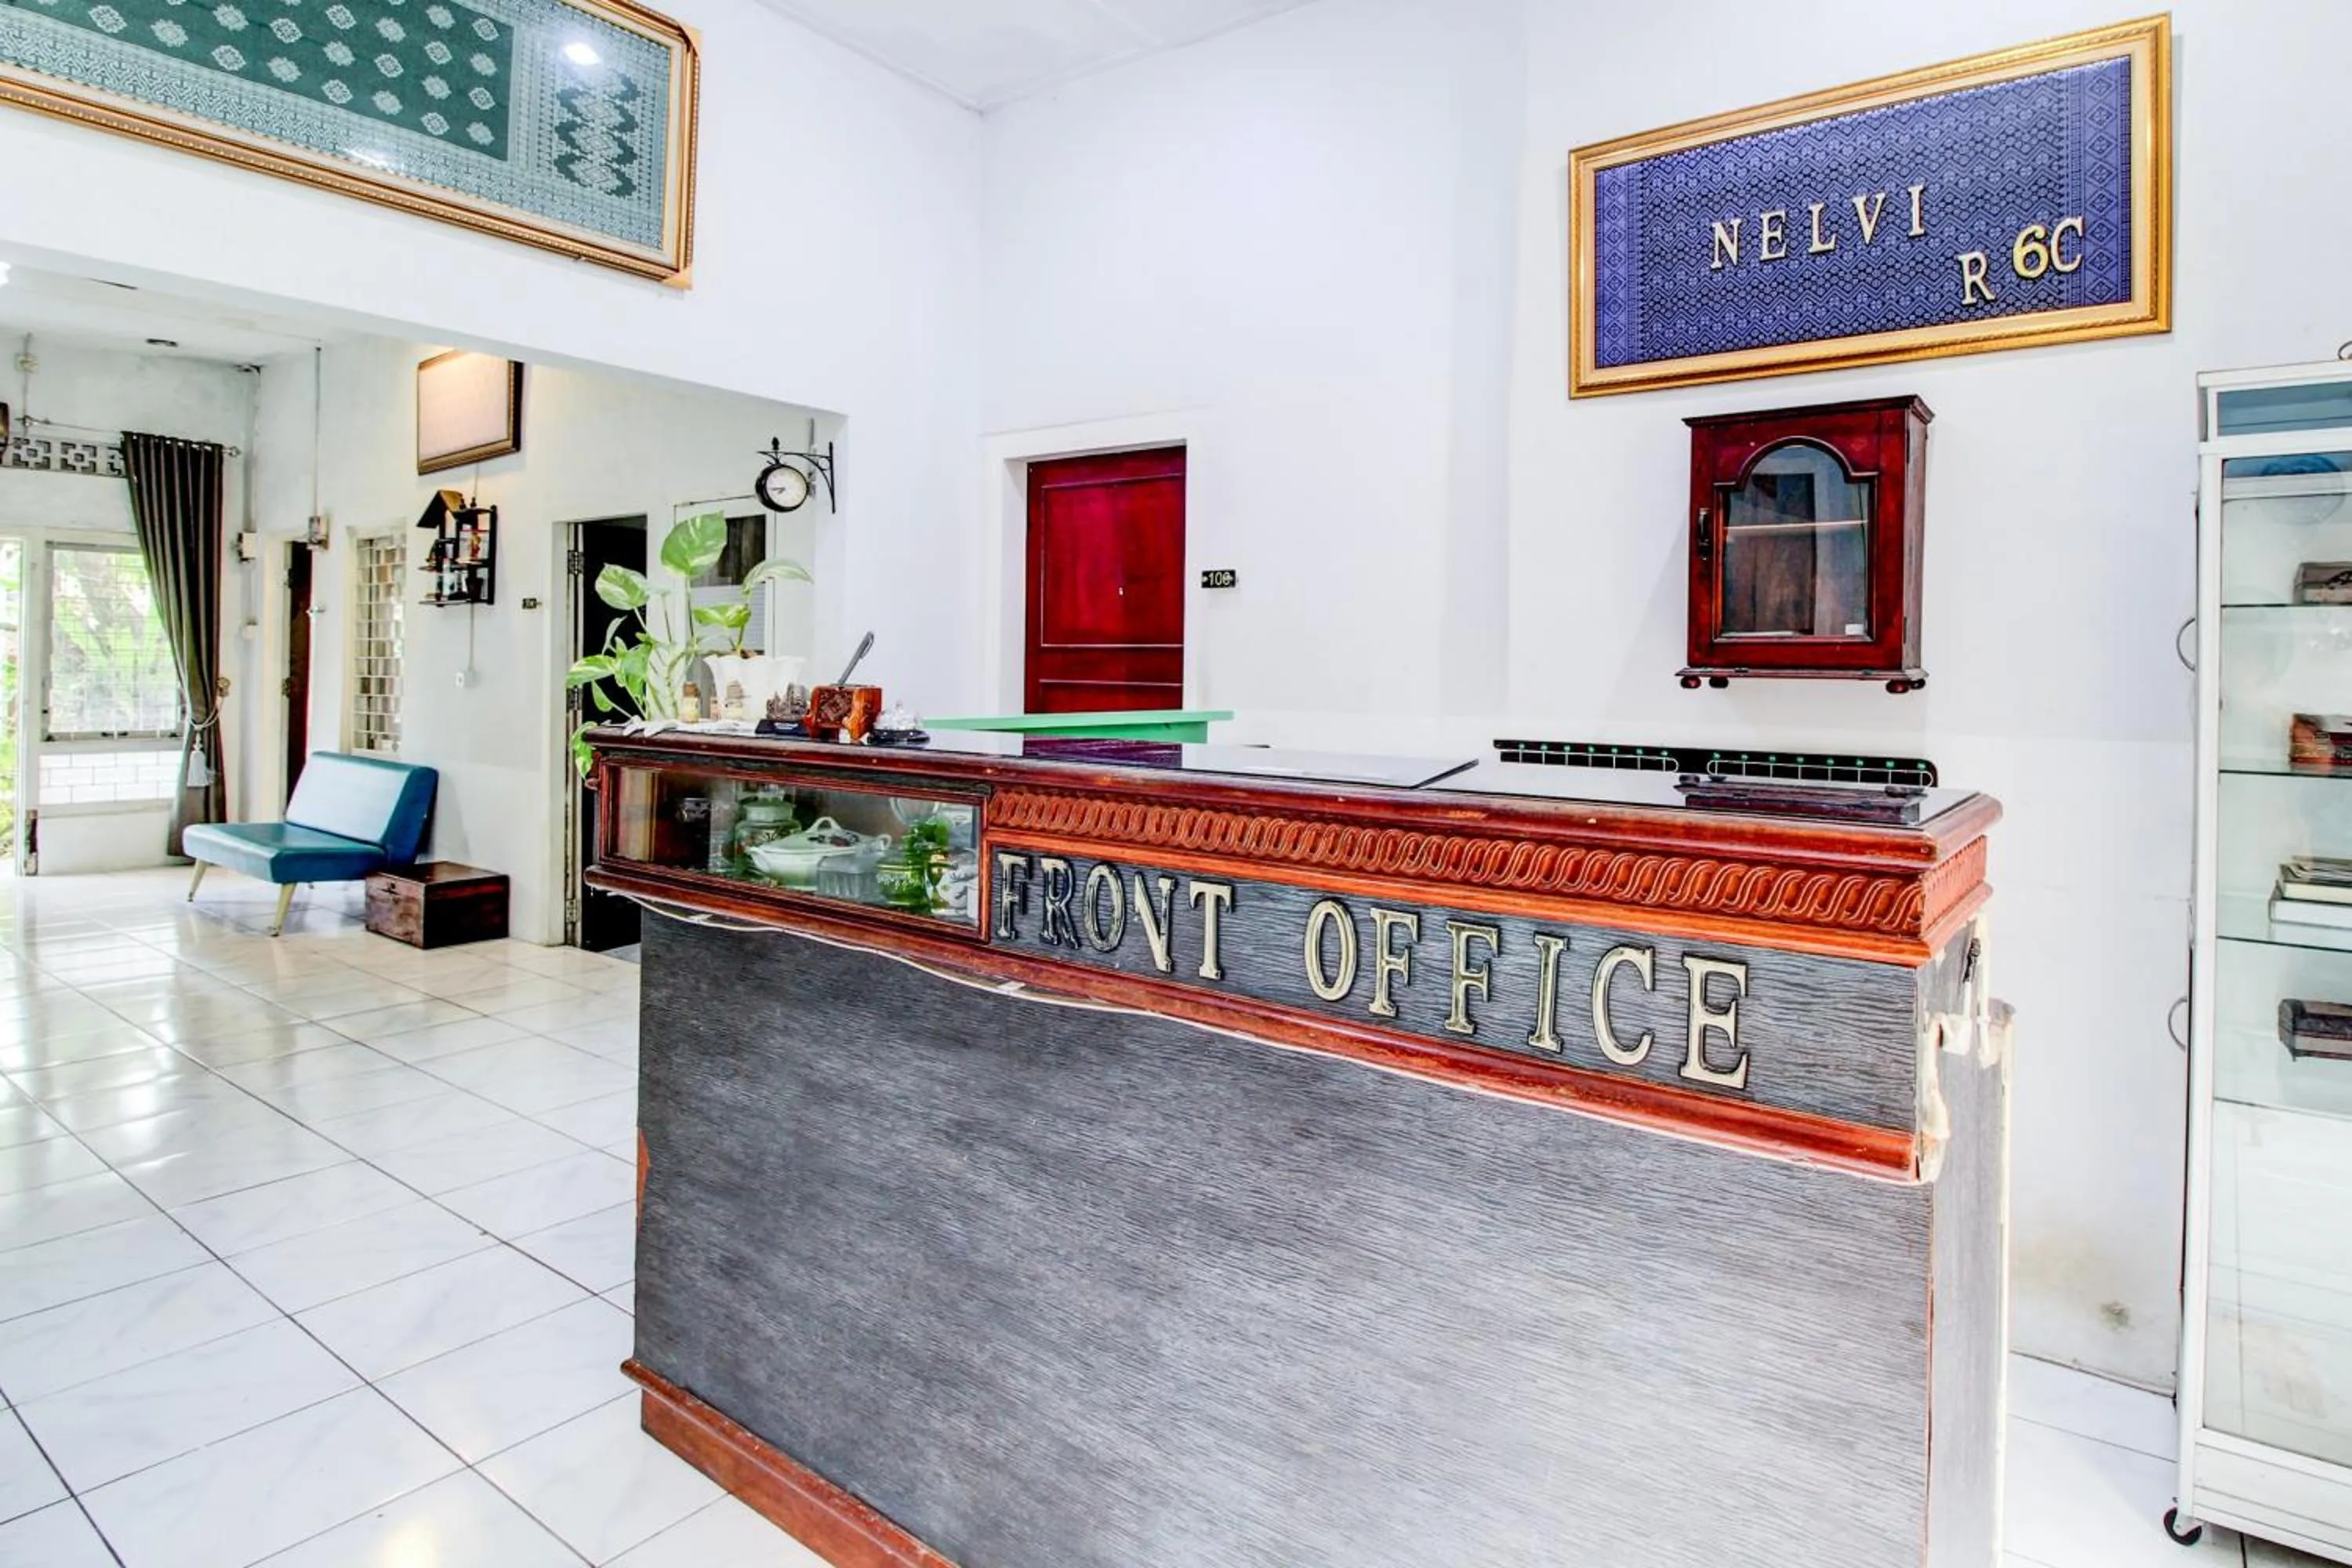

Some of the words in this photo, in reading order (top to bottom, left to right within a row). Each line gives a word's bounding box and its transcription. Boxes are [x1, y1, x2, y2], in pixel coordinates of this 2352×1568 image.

[1710, 183, 1925, 270] NELVI
[996, 851, 1235, 980] FRONT
[1303, 898, 1750, 1090] OFFICE
